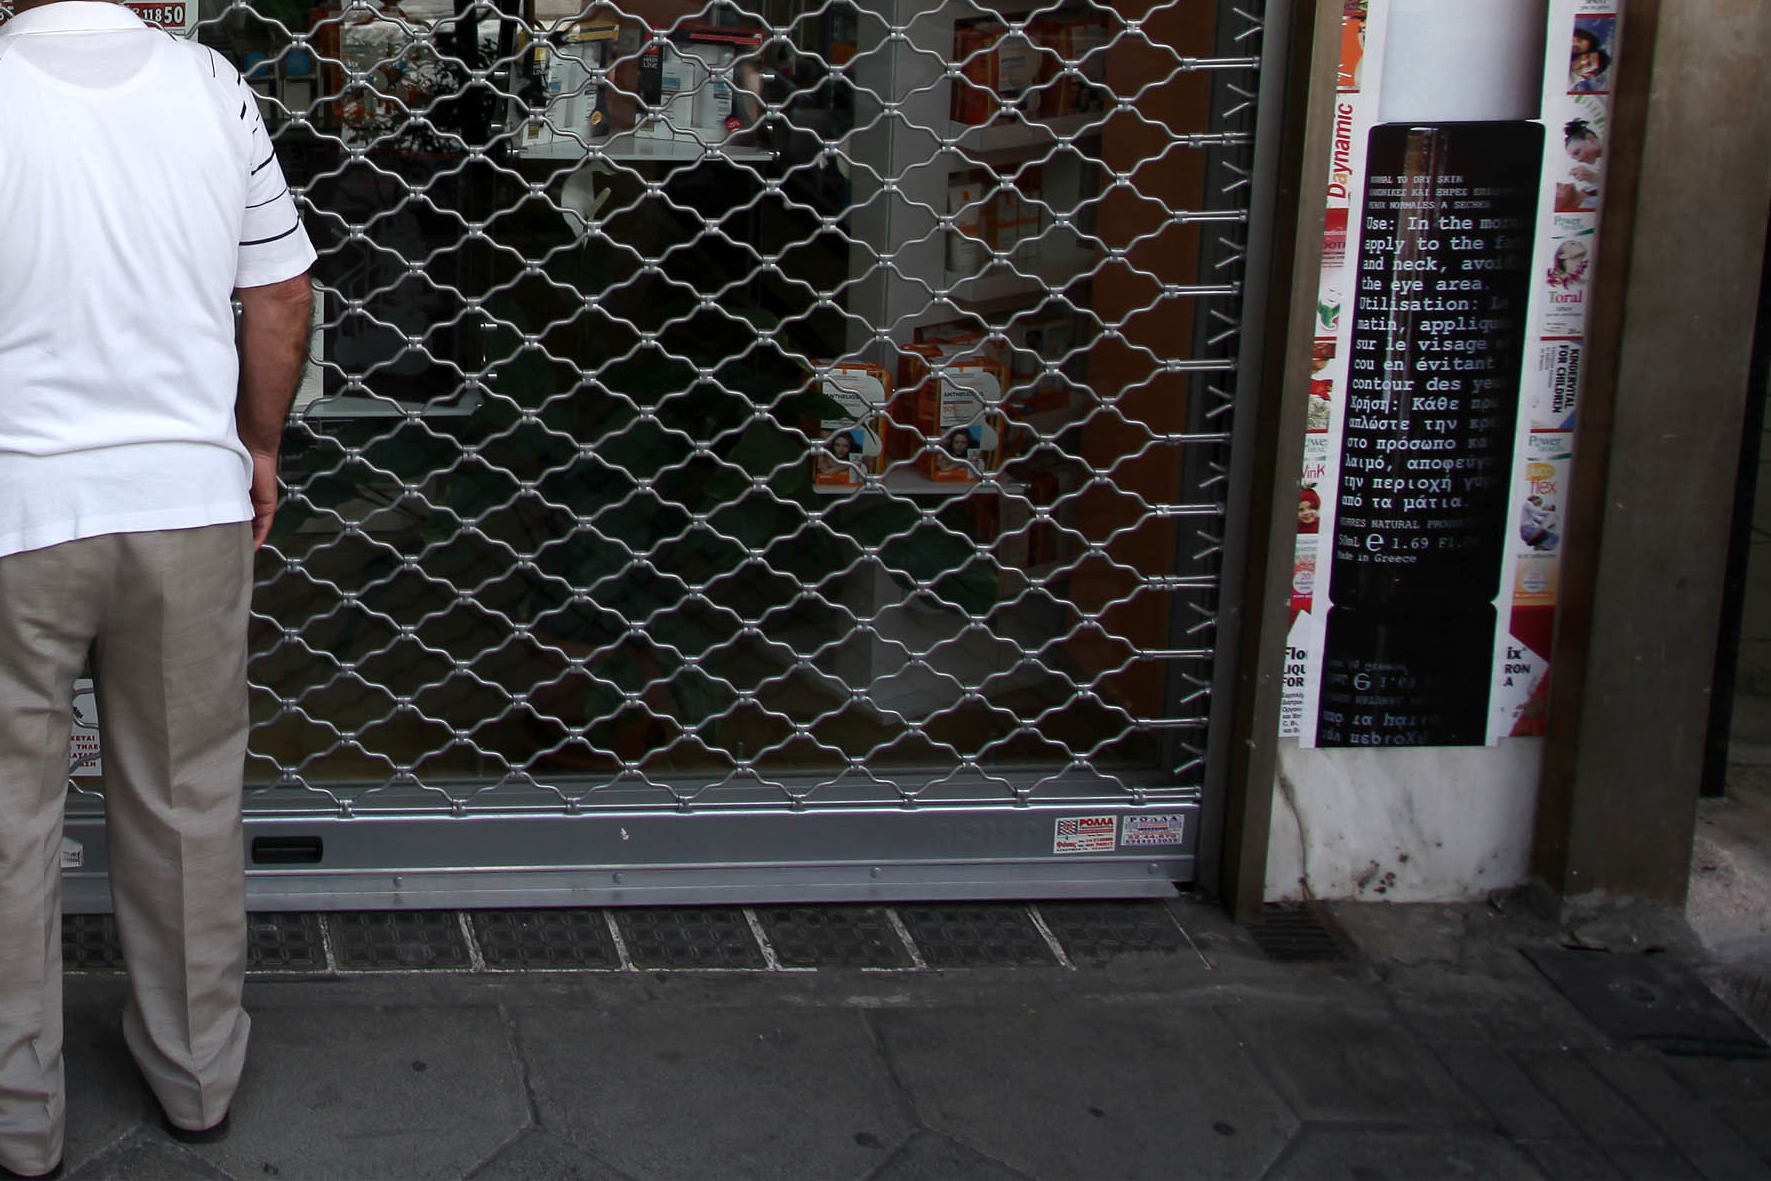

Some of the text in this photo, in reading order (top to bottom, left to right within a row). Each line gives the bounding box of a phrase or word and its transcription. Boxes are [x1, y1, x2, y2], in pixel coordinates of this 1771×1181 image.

[1327, 103, 1353, 198] Daynamic
[1437, 175, 1464, 184] SKIN
[1366, 217, 1395, 230] Use:
[1407, 217, 1430, 230] In
[1438, 216, 1473, 230] the
[1365, 236, 1405, 254] apply
[1416, 237, 1440, 250] to
[1449, 236, 1484, 250] the
[1363, 257, 1384, 270] and
[1393, 257, 1447, 273] neck,
[1361, 276, 1490, 295] the eye area.
[1359, 296, 1477, 310] Utilisation:
[1549, 291, 1582, 303] Toral
[1356, 317, 1404, 333] matin,
[1356, 337, 1487, 354] sur le visage
[1354, 359, 1375, 370] cou
[1383, 359, 1404, 370] en
[1352, 378, 1415, 390] contour
[1425, 377, 1462, 390] des
[1552, 367, 1566, 413] CHILDREN
[1412, 397, 1460, 411] Κάθε
[1348, 416, 1410, 430] απλώστε
[1424, 419, 1458, 434] την
[1347, 437, 1367, 448] στο
[1376, 436, 1457, 453] πρόσωπο
[1345, 453, 1392, 472] λαιμό,
[1344, 475, 1452, 492] την περιοχή
[1341, 493, 1468, 512] από τα μάτια.
[1371, 520, 1421, 529] NATURAL
[1392, 538, 1430, 550] 1.69
[1374, 554, 1418, 563] Greece
[1507, 647, 1522, 659] ix
[1080, 818, 1113, 826] ΡΟΛΛΑ
